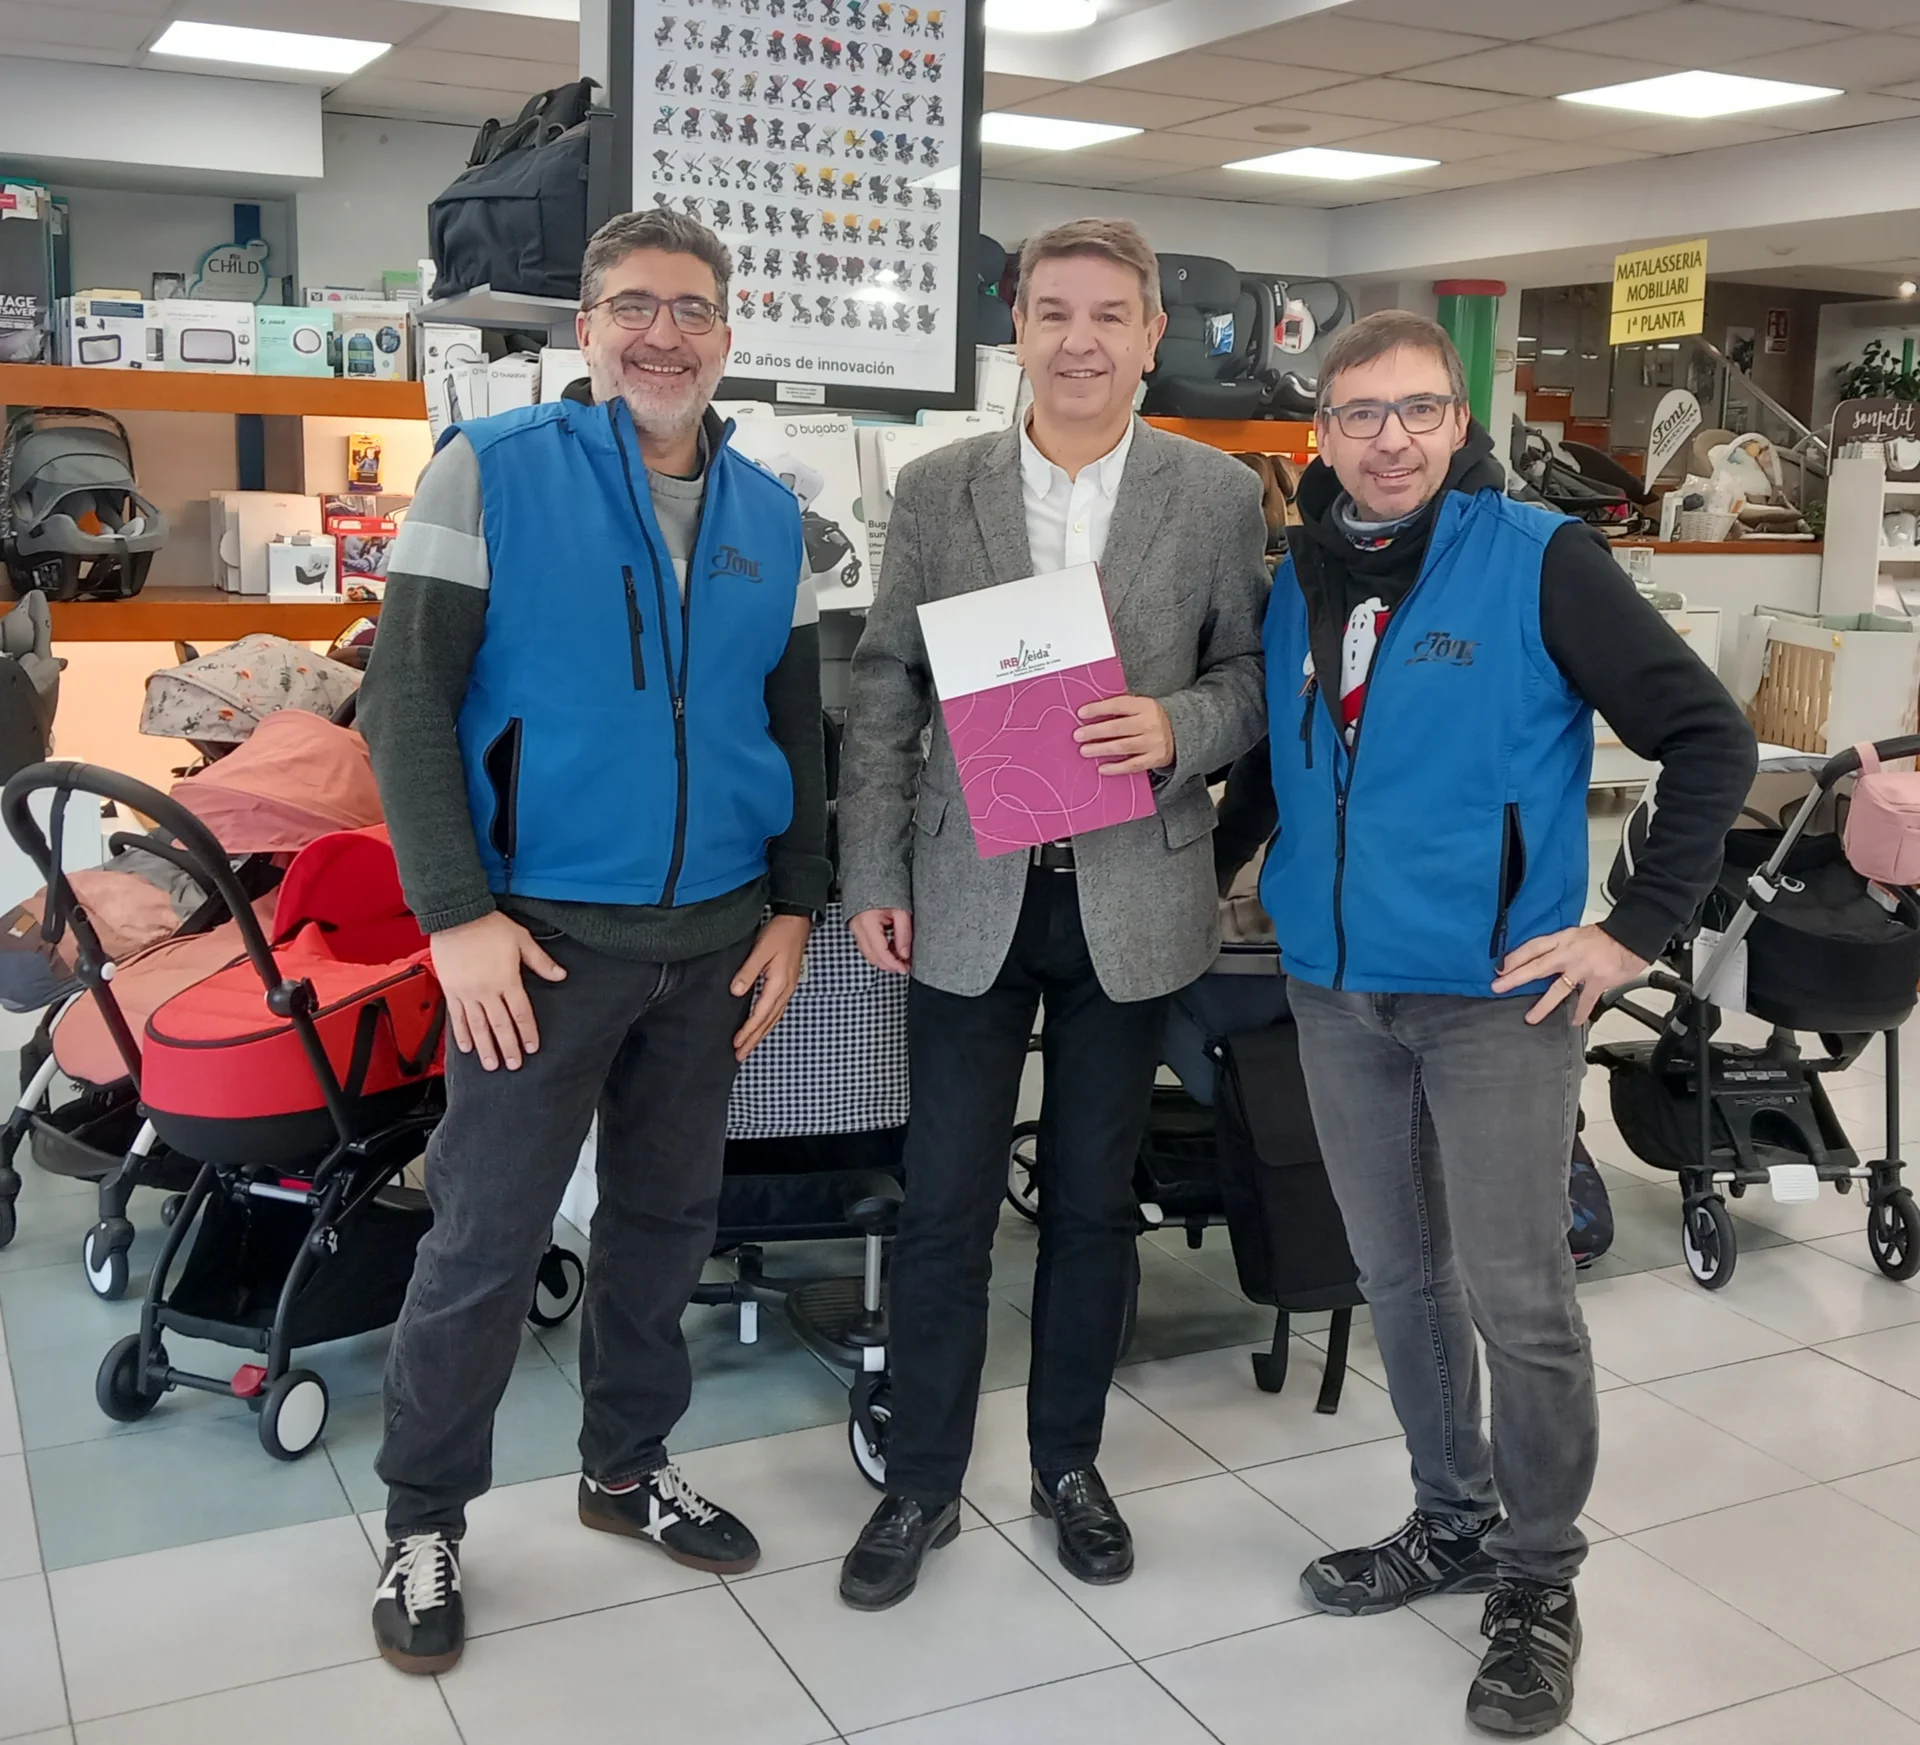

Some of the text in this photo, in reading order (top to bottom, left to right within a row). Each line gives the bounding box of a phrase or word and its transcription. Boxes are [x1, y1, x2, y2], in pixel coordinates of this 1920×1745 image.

[208, 258, 259, 275] CHILD
[1616, 250, 1702, 281] MATALASSERIA
[1626, 276, 1689, 302] MOBILIARI
[1640, 310, 1686, 332] PLANTA
[733, 351, 895, 375] 20 años de innovación
[1852, 402, 1916, 437] sonpetit
